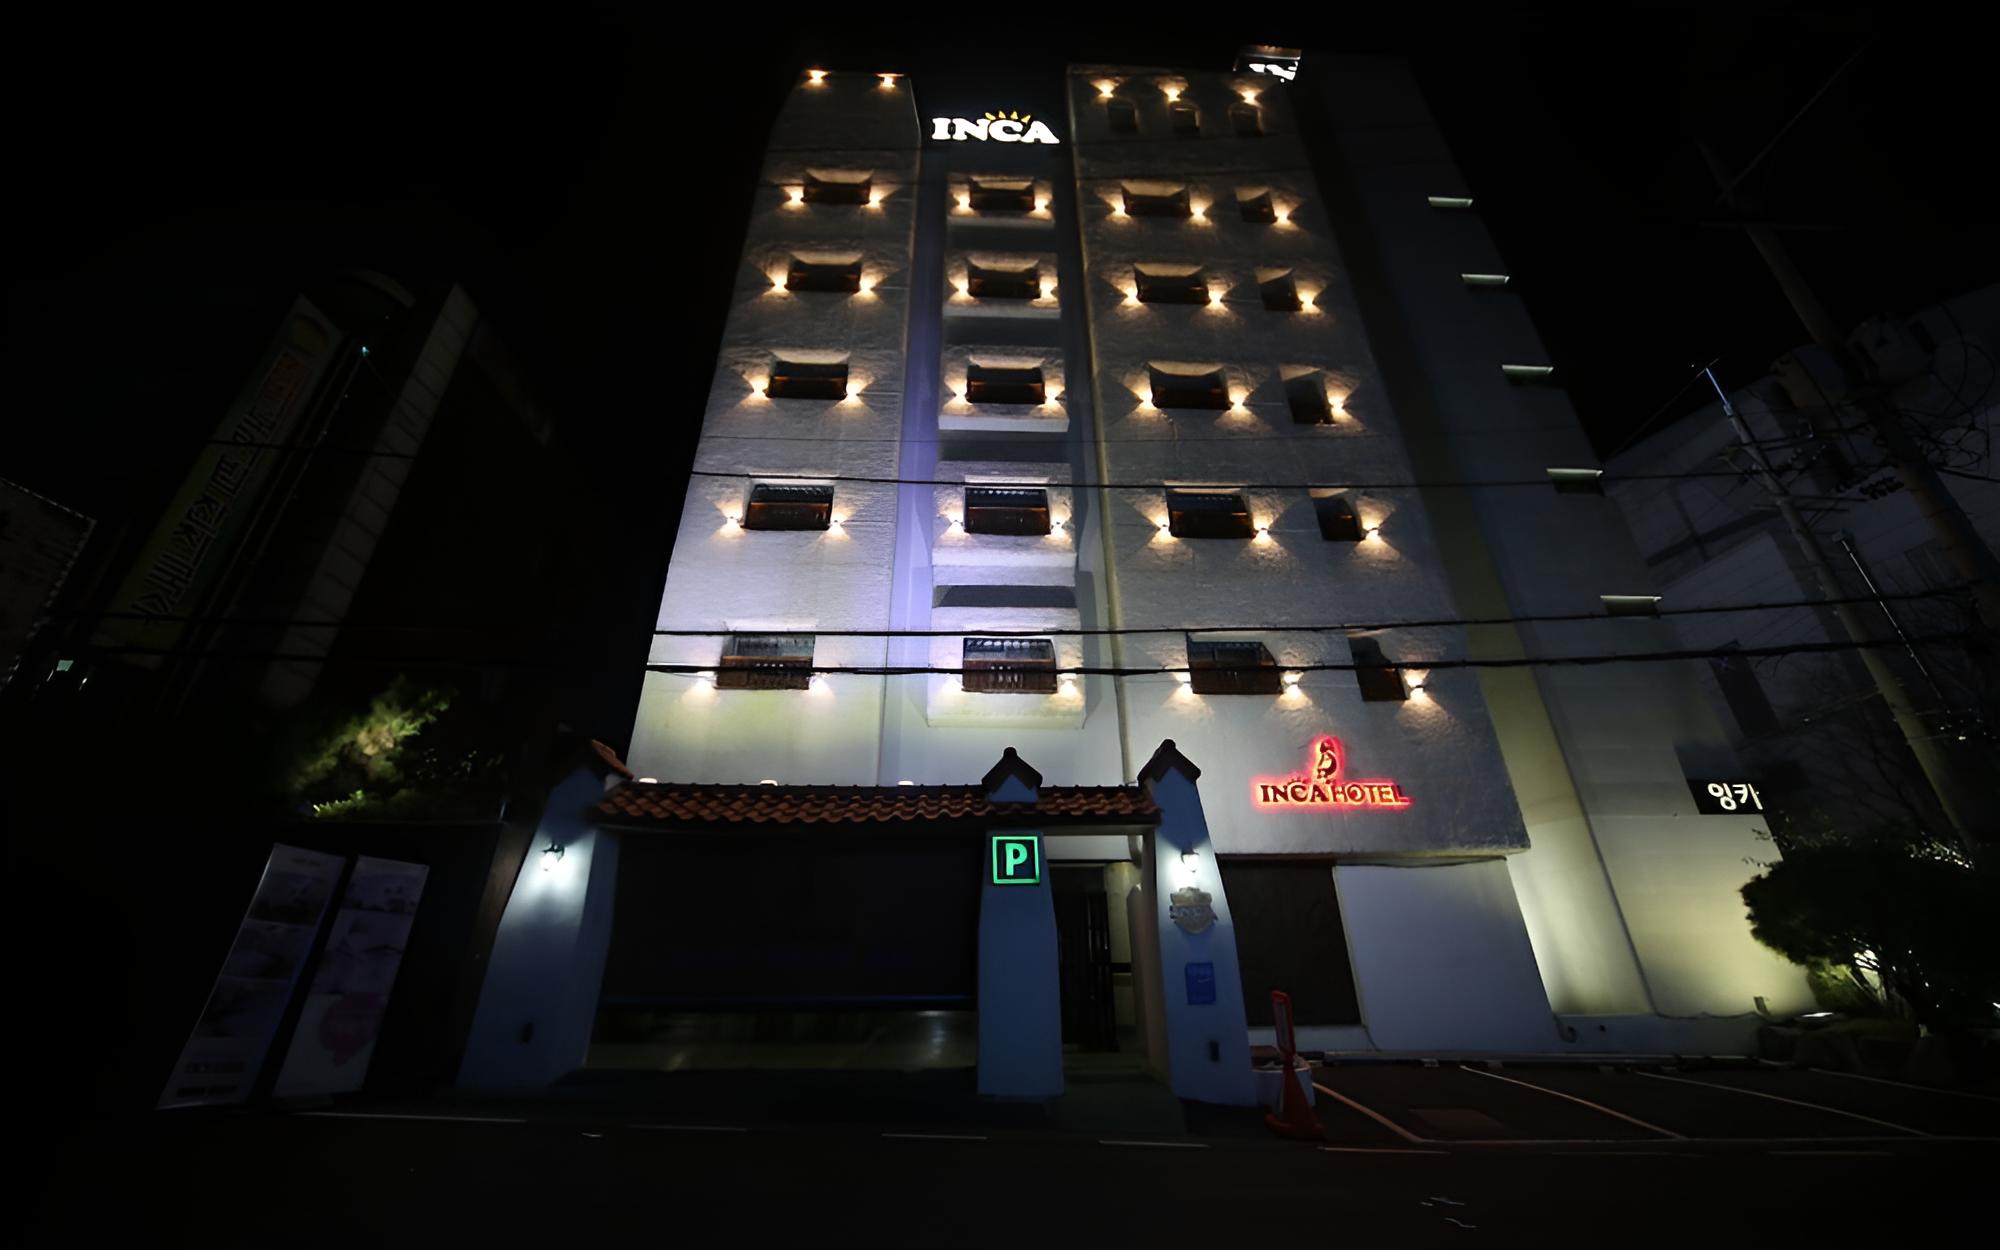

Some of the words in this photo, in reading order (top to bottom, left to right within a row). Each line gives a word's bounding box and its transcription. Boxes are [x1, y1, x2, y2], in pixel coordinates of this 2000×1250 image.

[931, 116, 1061, 144] INCA
[1259, 783, 1329, 803] INCA
[1331, 783, 1413, 805] HOTEL
[1707, 782, 1763, 811] 잉카
[1005, 842, 1028, 876] P
